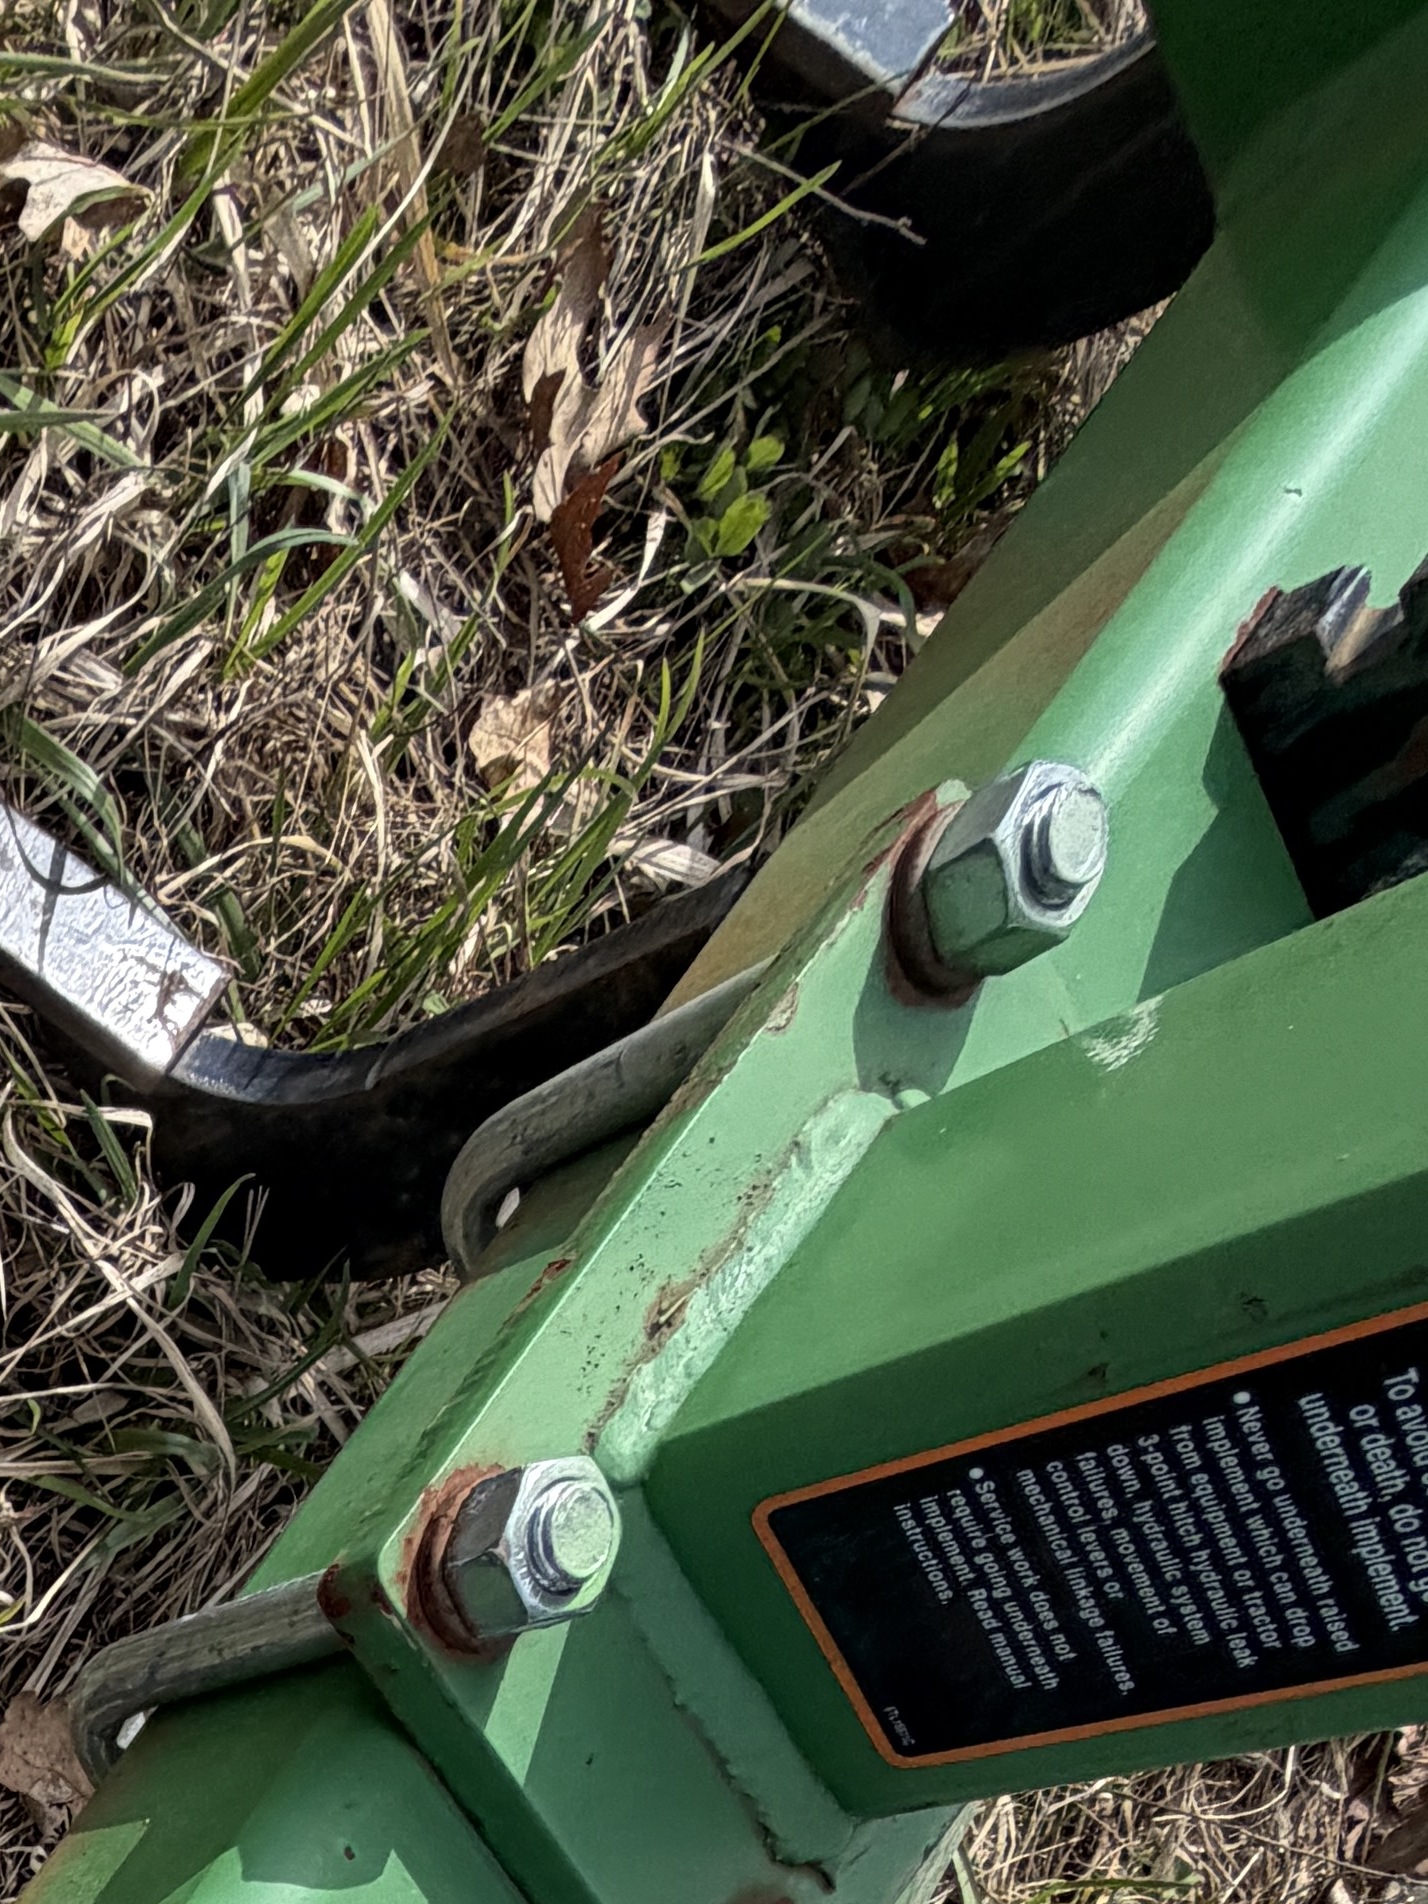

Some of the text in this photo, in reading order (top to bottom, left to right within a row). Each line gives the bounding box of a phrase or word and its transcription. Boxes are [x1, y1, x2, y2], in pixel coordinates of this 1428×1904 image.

[1348, 1403, 1380, 1428] or
[1359, 1433, 1411, 1503] death,
[1383, 1366, 1420, 1401] To
[893, 1502, 954, 1605] instructions.
[918, 1494, 1033, 1689] implement. Read manual
[946, 1488, 1060, 1690] require going underneath
[974, 1480, 1078, 1662] Service work does not
[1015, 1469, 1135, 1696] mechanical linkage failures.
[1045, 1460, 1125, 1599] control levers or
[1109, 1527, 1167, 1615] movement
[1152, 1617, 1178, 1635] of
[1131, 1499, 1184, 1582] hydraulic
[1169, 1585, 1211, 1645] system
[1137, 1433, 1259, 1669] 3-point hitch hydraulic leak
[1168, 1424, 1283, 1649] from equipment or tractor
[1202, 1415, 1316, 1648] implement which can drop
[1235, 1405, 1361, 1652] Never go underneath raised
[1297, 1392, 1420, 1632] underneath implement.
[1387, 1503, 1424, 1534] do
